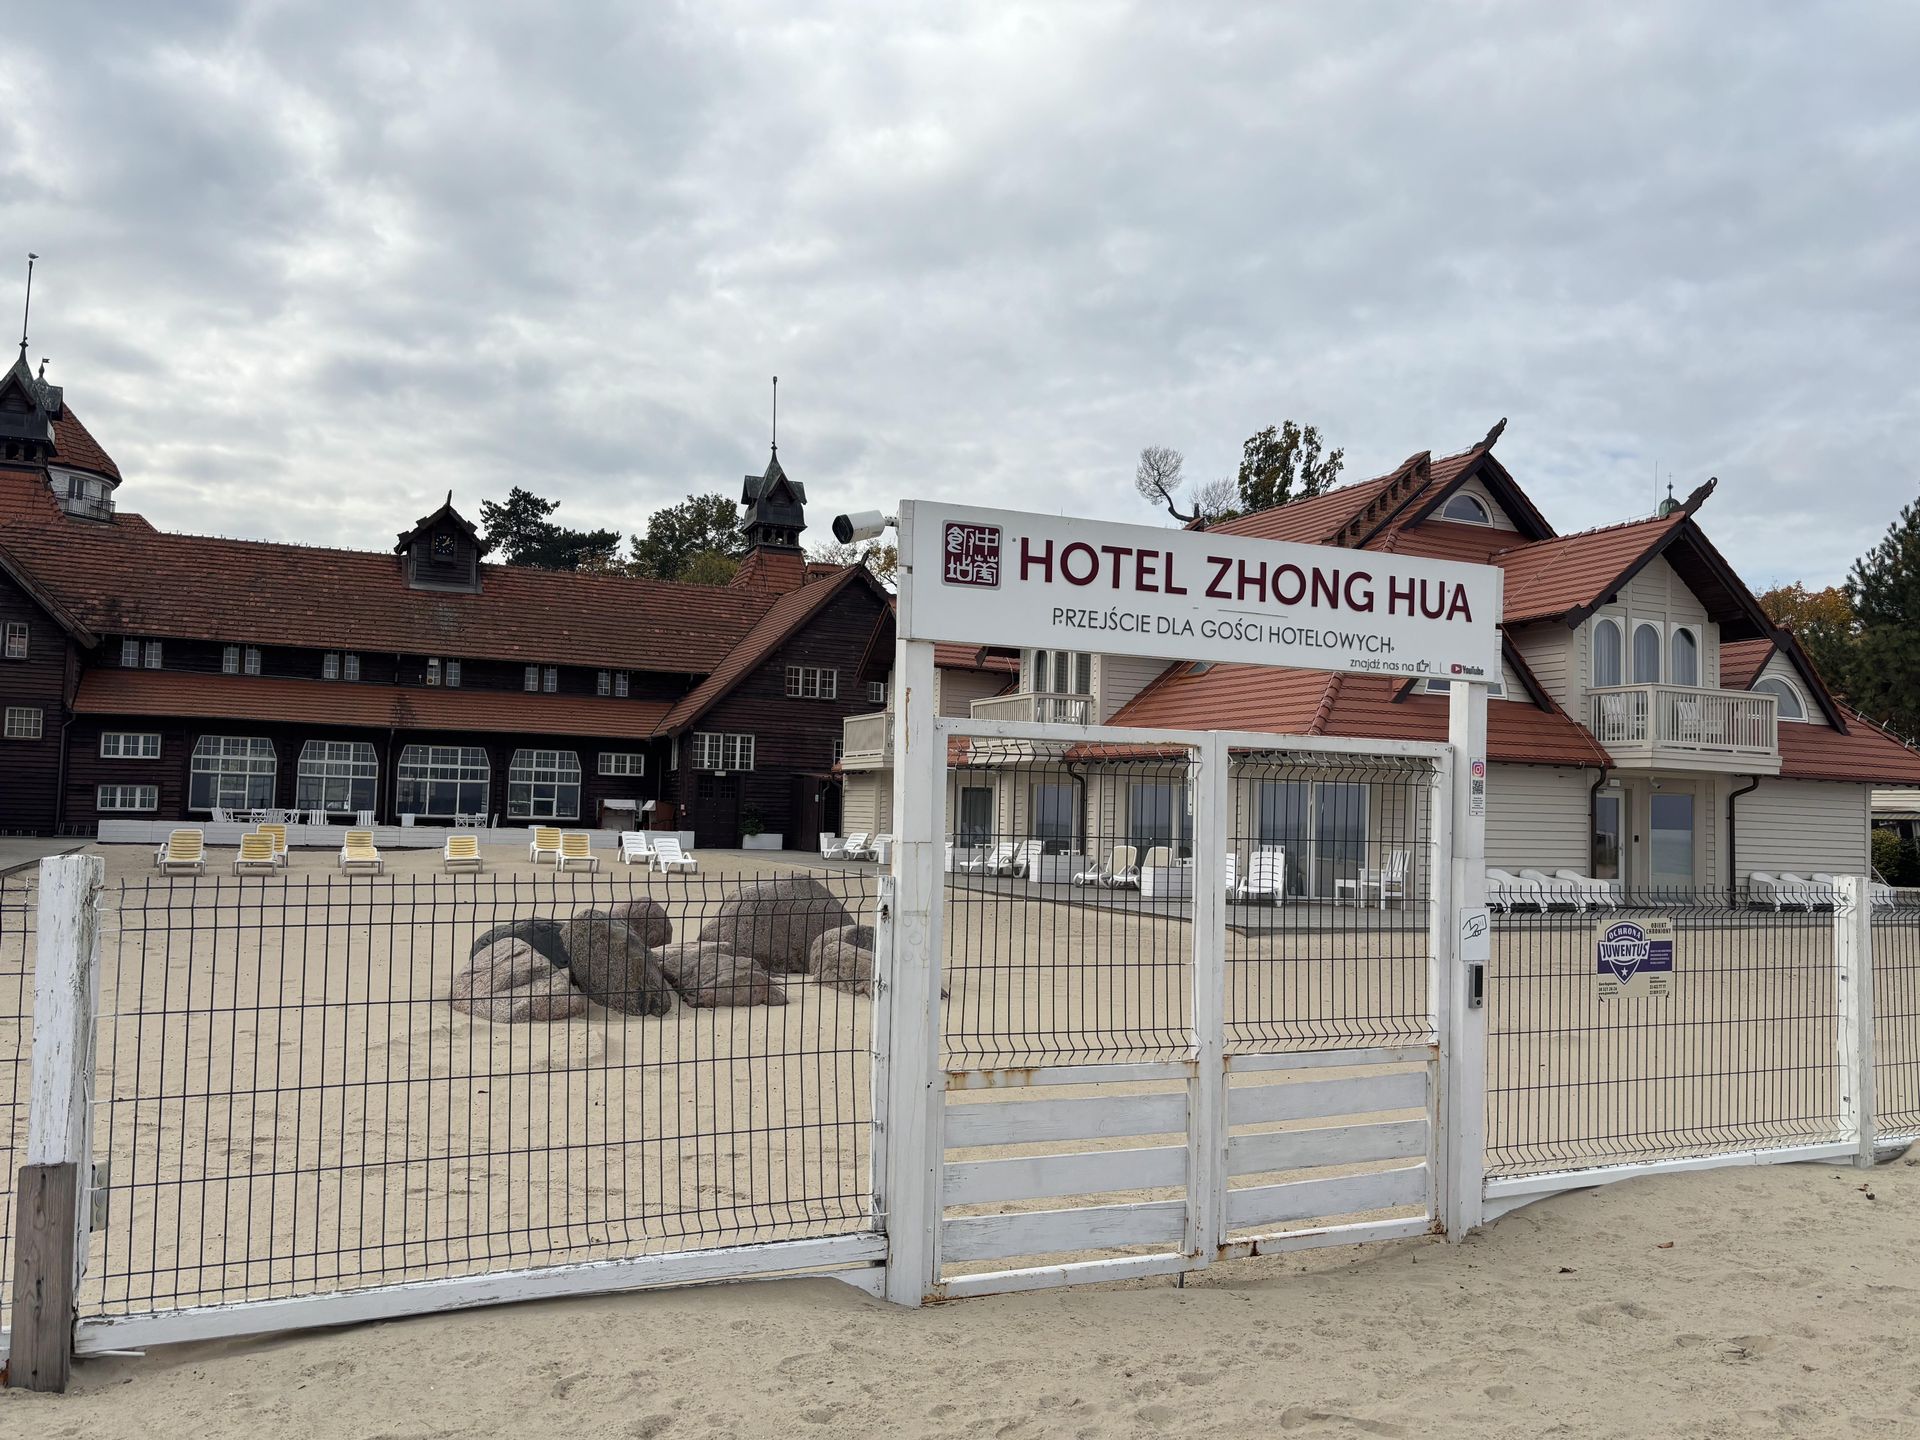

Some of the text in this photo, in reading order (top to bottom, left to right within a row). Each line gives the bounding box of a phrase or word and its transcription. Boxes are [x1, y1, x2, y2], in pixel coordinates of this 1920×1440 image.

[1020, 536, 1472, 623] HOTEL ZHONG HUA
[1052, 606, 1391, 654] PRZEJŚCIE DLA GOŚCI HOTELOWYCH
[1350, 658, 1484, 676] znajdź nas na YouTube
[1608, 927, 1641, 939] OCHRONA
[1601, 942, 1649, 959] JUWENTUS
